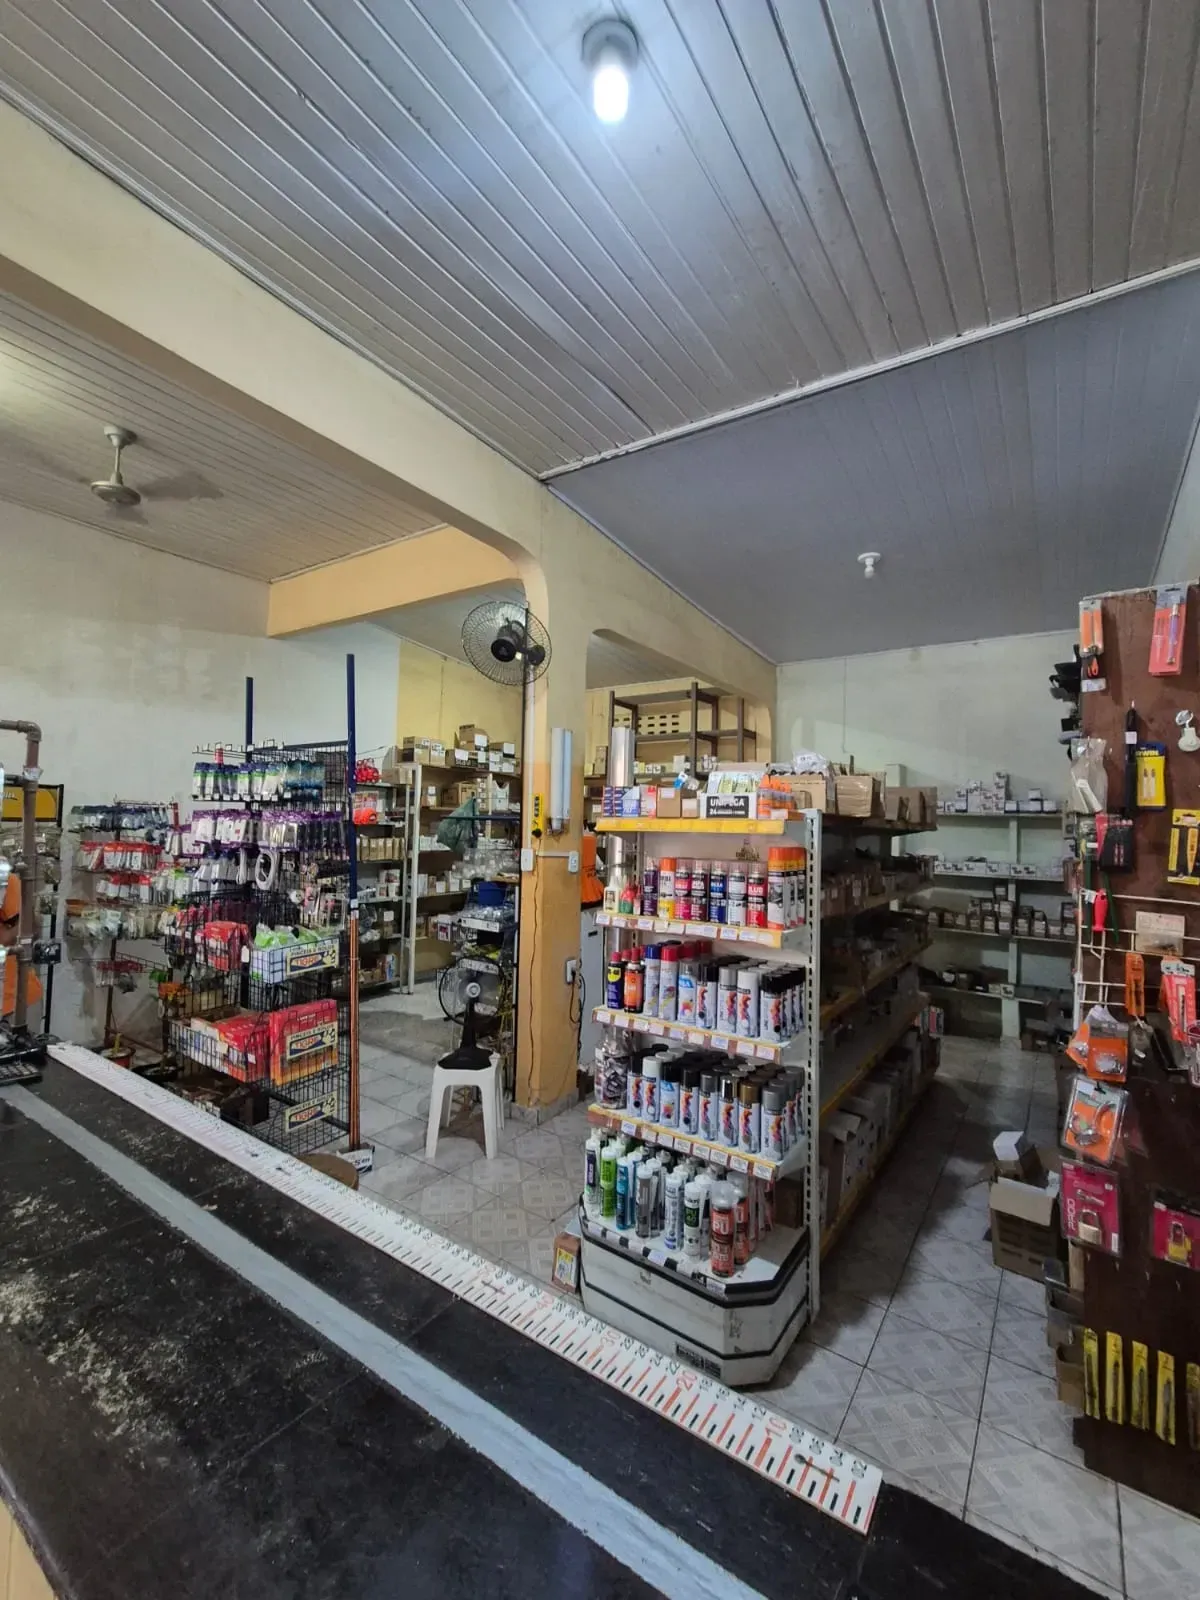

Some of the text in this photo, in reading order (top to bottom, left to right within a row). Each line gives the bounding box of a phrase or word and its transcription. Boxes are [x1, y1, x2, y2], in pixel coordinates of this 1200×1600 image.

[712, 1220, 730, 1235] PU
[676, 1370, 698, 1392] 20
[765, 1416, 788, 1438] 10
